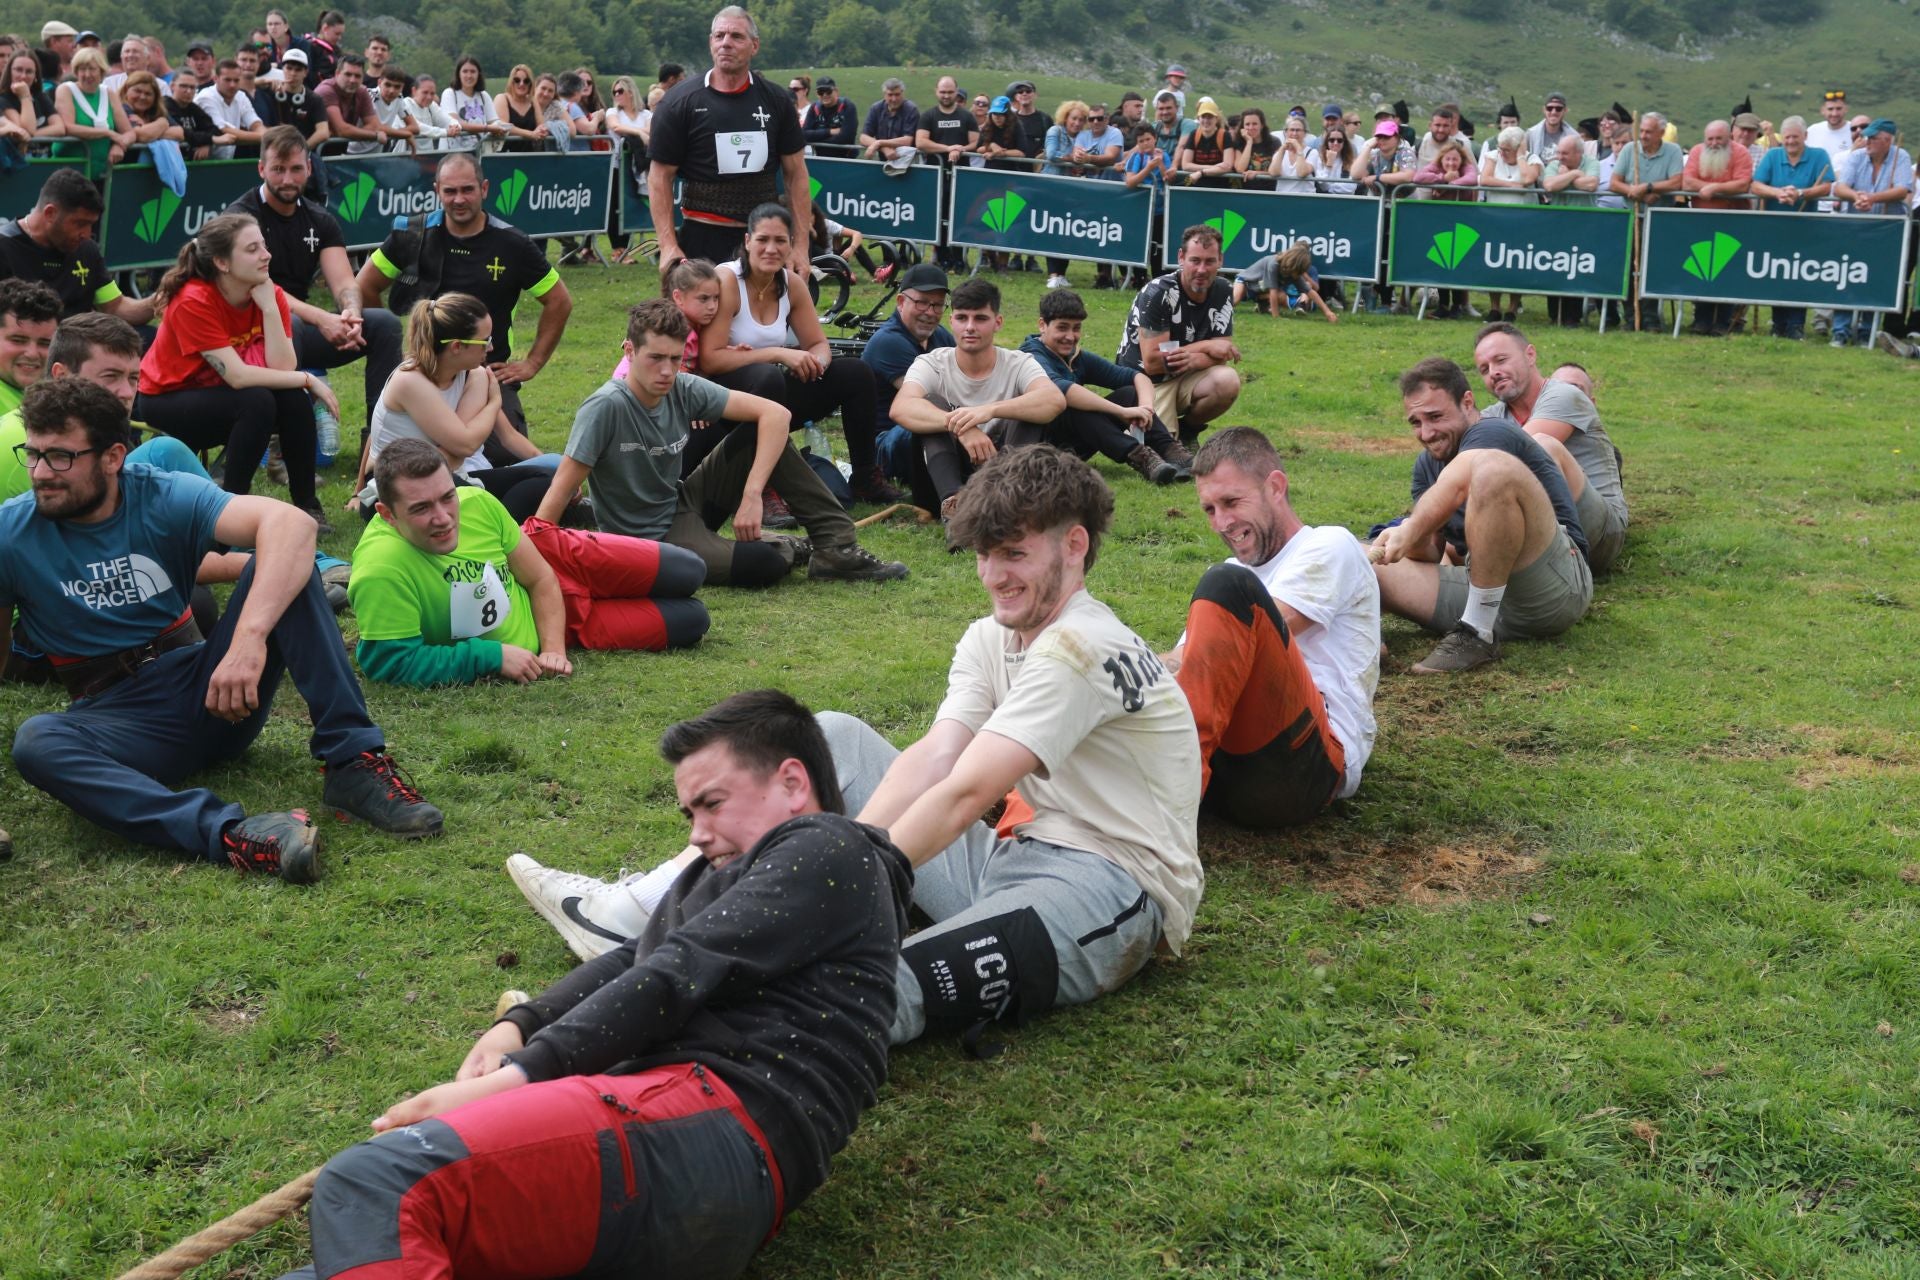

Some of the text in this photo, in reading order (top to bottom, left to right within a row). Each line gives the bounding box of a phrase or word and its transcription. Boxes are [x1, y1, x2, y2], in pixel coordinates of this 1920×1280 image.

[737, 149, 752, 168] 7
[529, 182, 592, 216] Unicaja
[826, 191, 915, 227] Unicaja
[1030, 208, 1123, 247] Unicaja
[1484, 241, 1596, 280] Unicaja
[1746, 251, 1868, 290] Unicaja
[86, 556, 131, 579] THE
[60, 572, 136, 597] NORTH
[83, 588, 140, 610] FACE
[481, 599, 498, 627] 8
